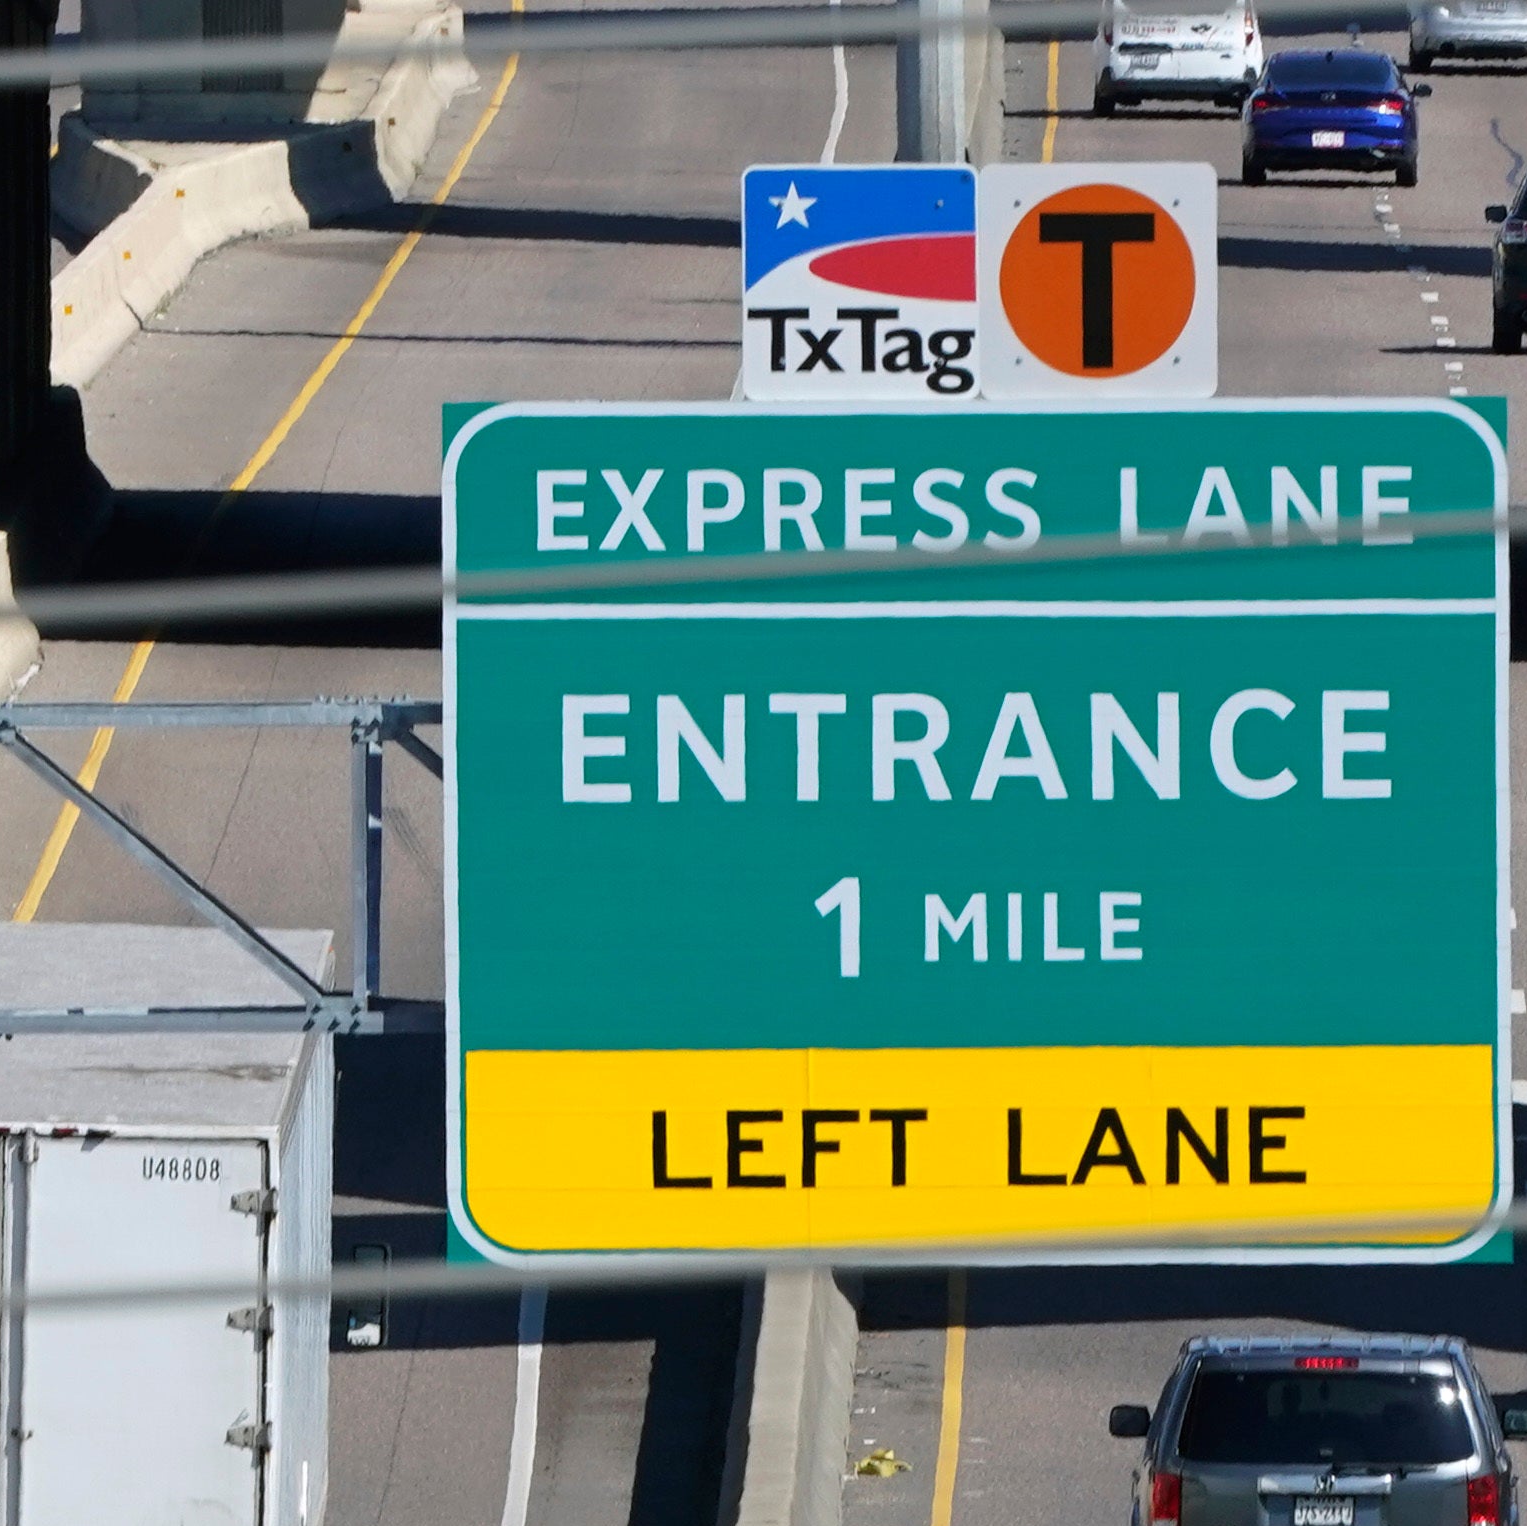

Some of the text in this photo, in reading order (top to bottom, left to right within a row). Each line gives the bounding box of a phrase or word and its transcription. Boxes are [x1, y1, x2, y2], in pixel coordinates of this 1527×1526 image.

[1038, 212, 1155, 369] T
[748, 308, 974, 393] TxTag
[536, 464, 1414, 553] EXPRESS LANE
[561, 688, 1392, 803] ENTRANCE
[814, 877, 1143, 977] 1 MILE
[143, 1157, 221, 1182] U48808
[651, 1106, 1307, 1189] LEFT LANE
